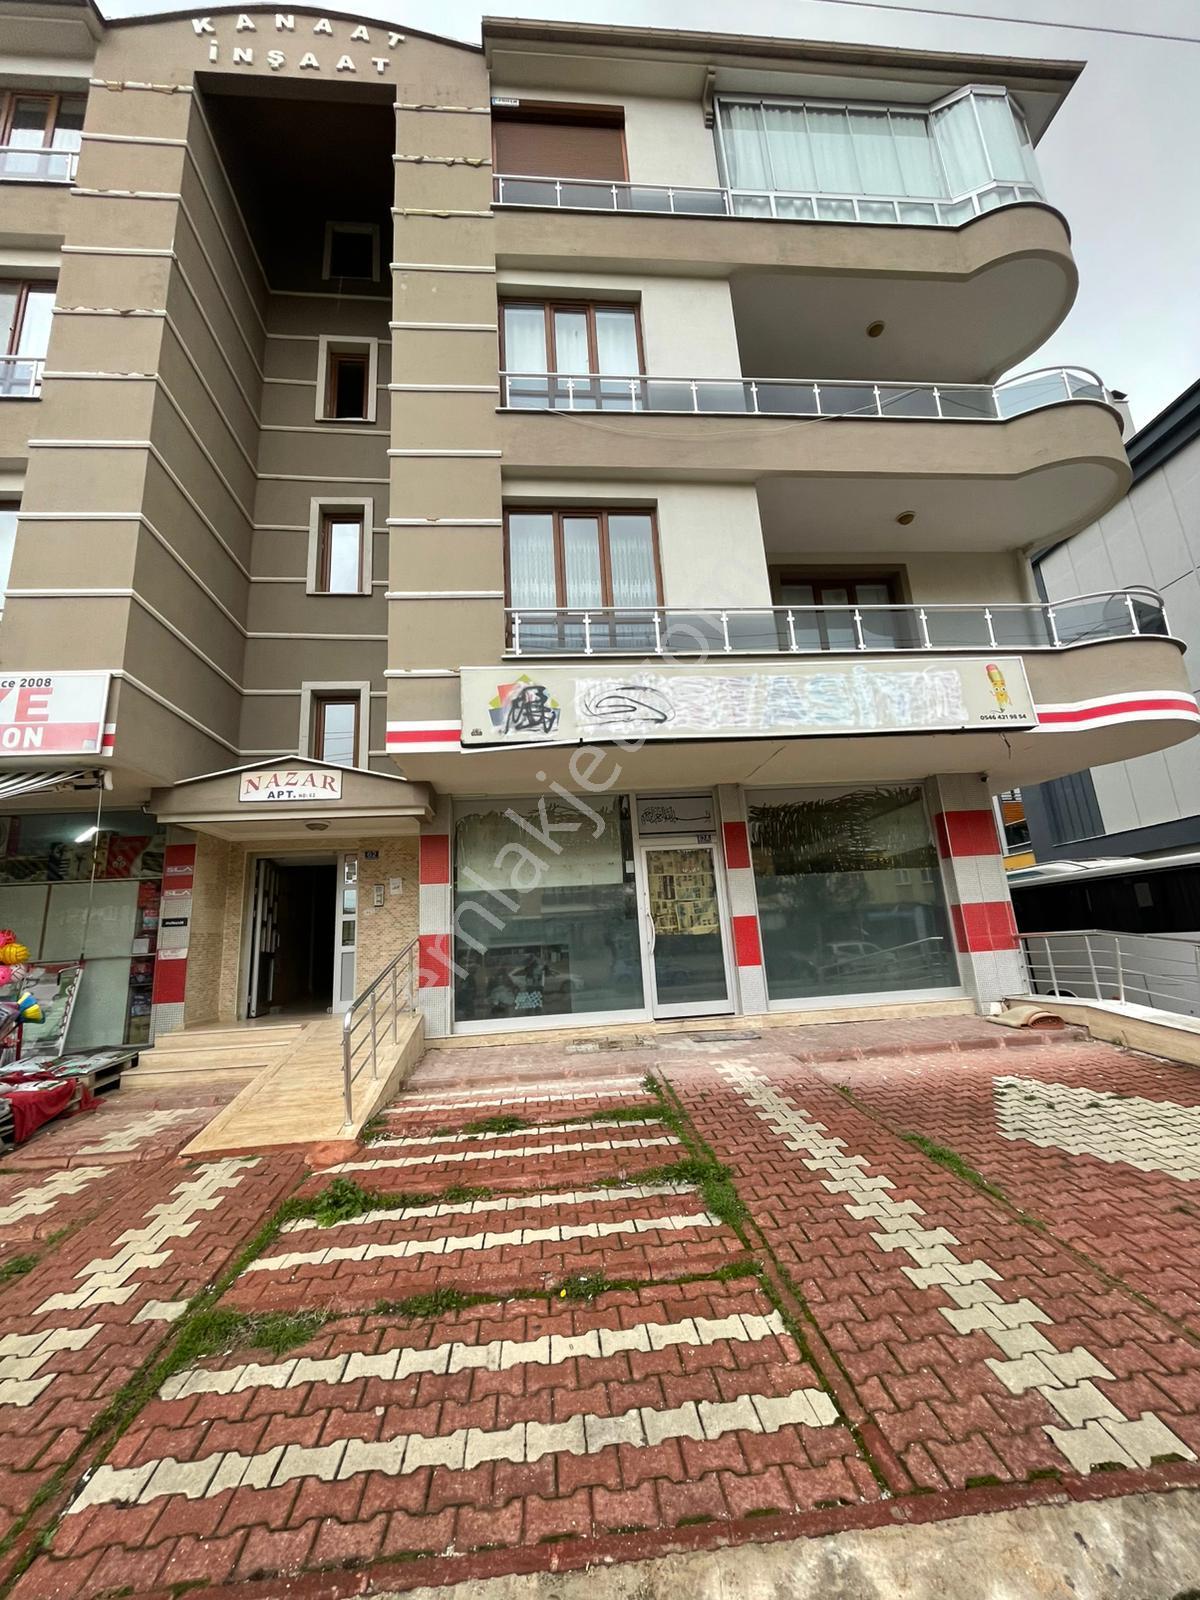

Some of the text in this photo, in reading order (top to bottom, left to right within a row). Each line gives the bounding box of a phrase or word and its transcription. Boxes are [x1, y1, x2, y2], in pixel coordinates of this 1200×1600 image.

[191, 13, 405, 50] KANAAT
[209, 39, 390, 75] İNŞAAT
[20, 678, 52, 688] 2008
[2, 726, 44, 749] ON
[243, 771, 338, 795] NAZAR
[267, 790, 296, 799] APT.
